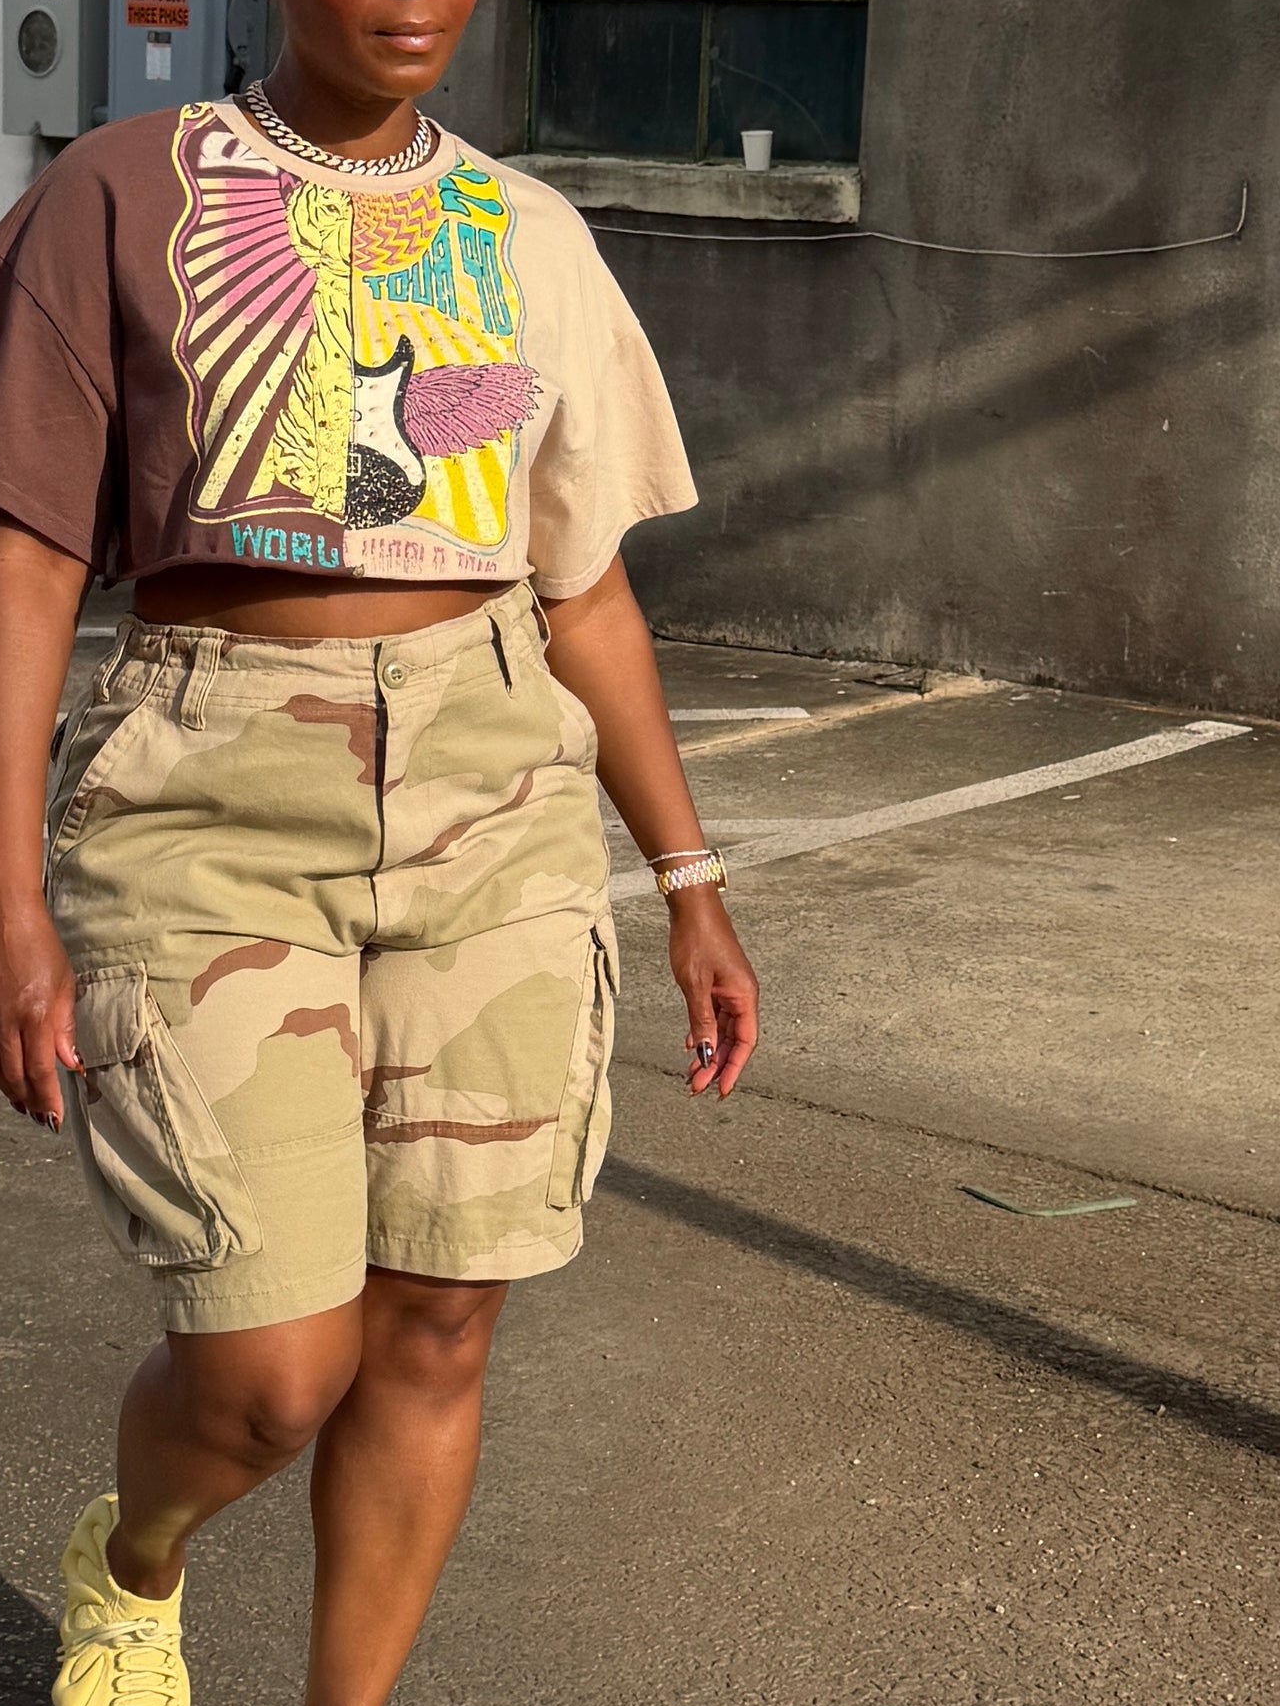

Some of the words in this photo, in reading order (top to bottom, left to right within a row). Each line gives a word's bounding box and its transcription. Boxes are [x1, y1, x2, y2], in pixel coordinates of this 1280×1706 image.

[128, 6, 157, 24] THREE
[159, 7, 188, 26] PHASE
[362, 219, 459, 321] TOUR
